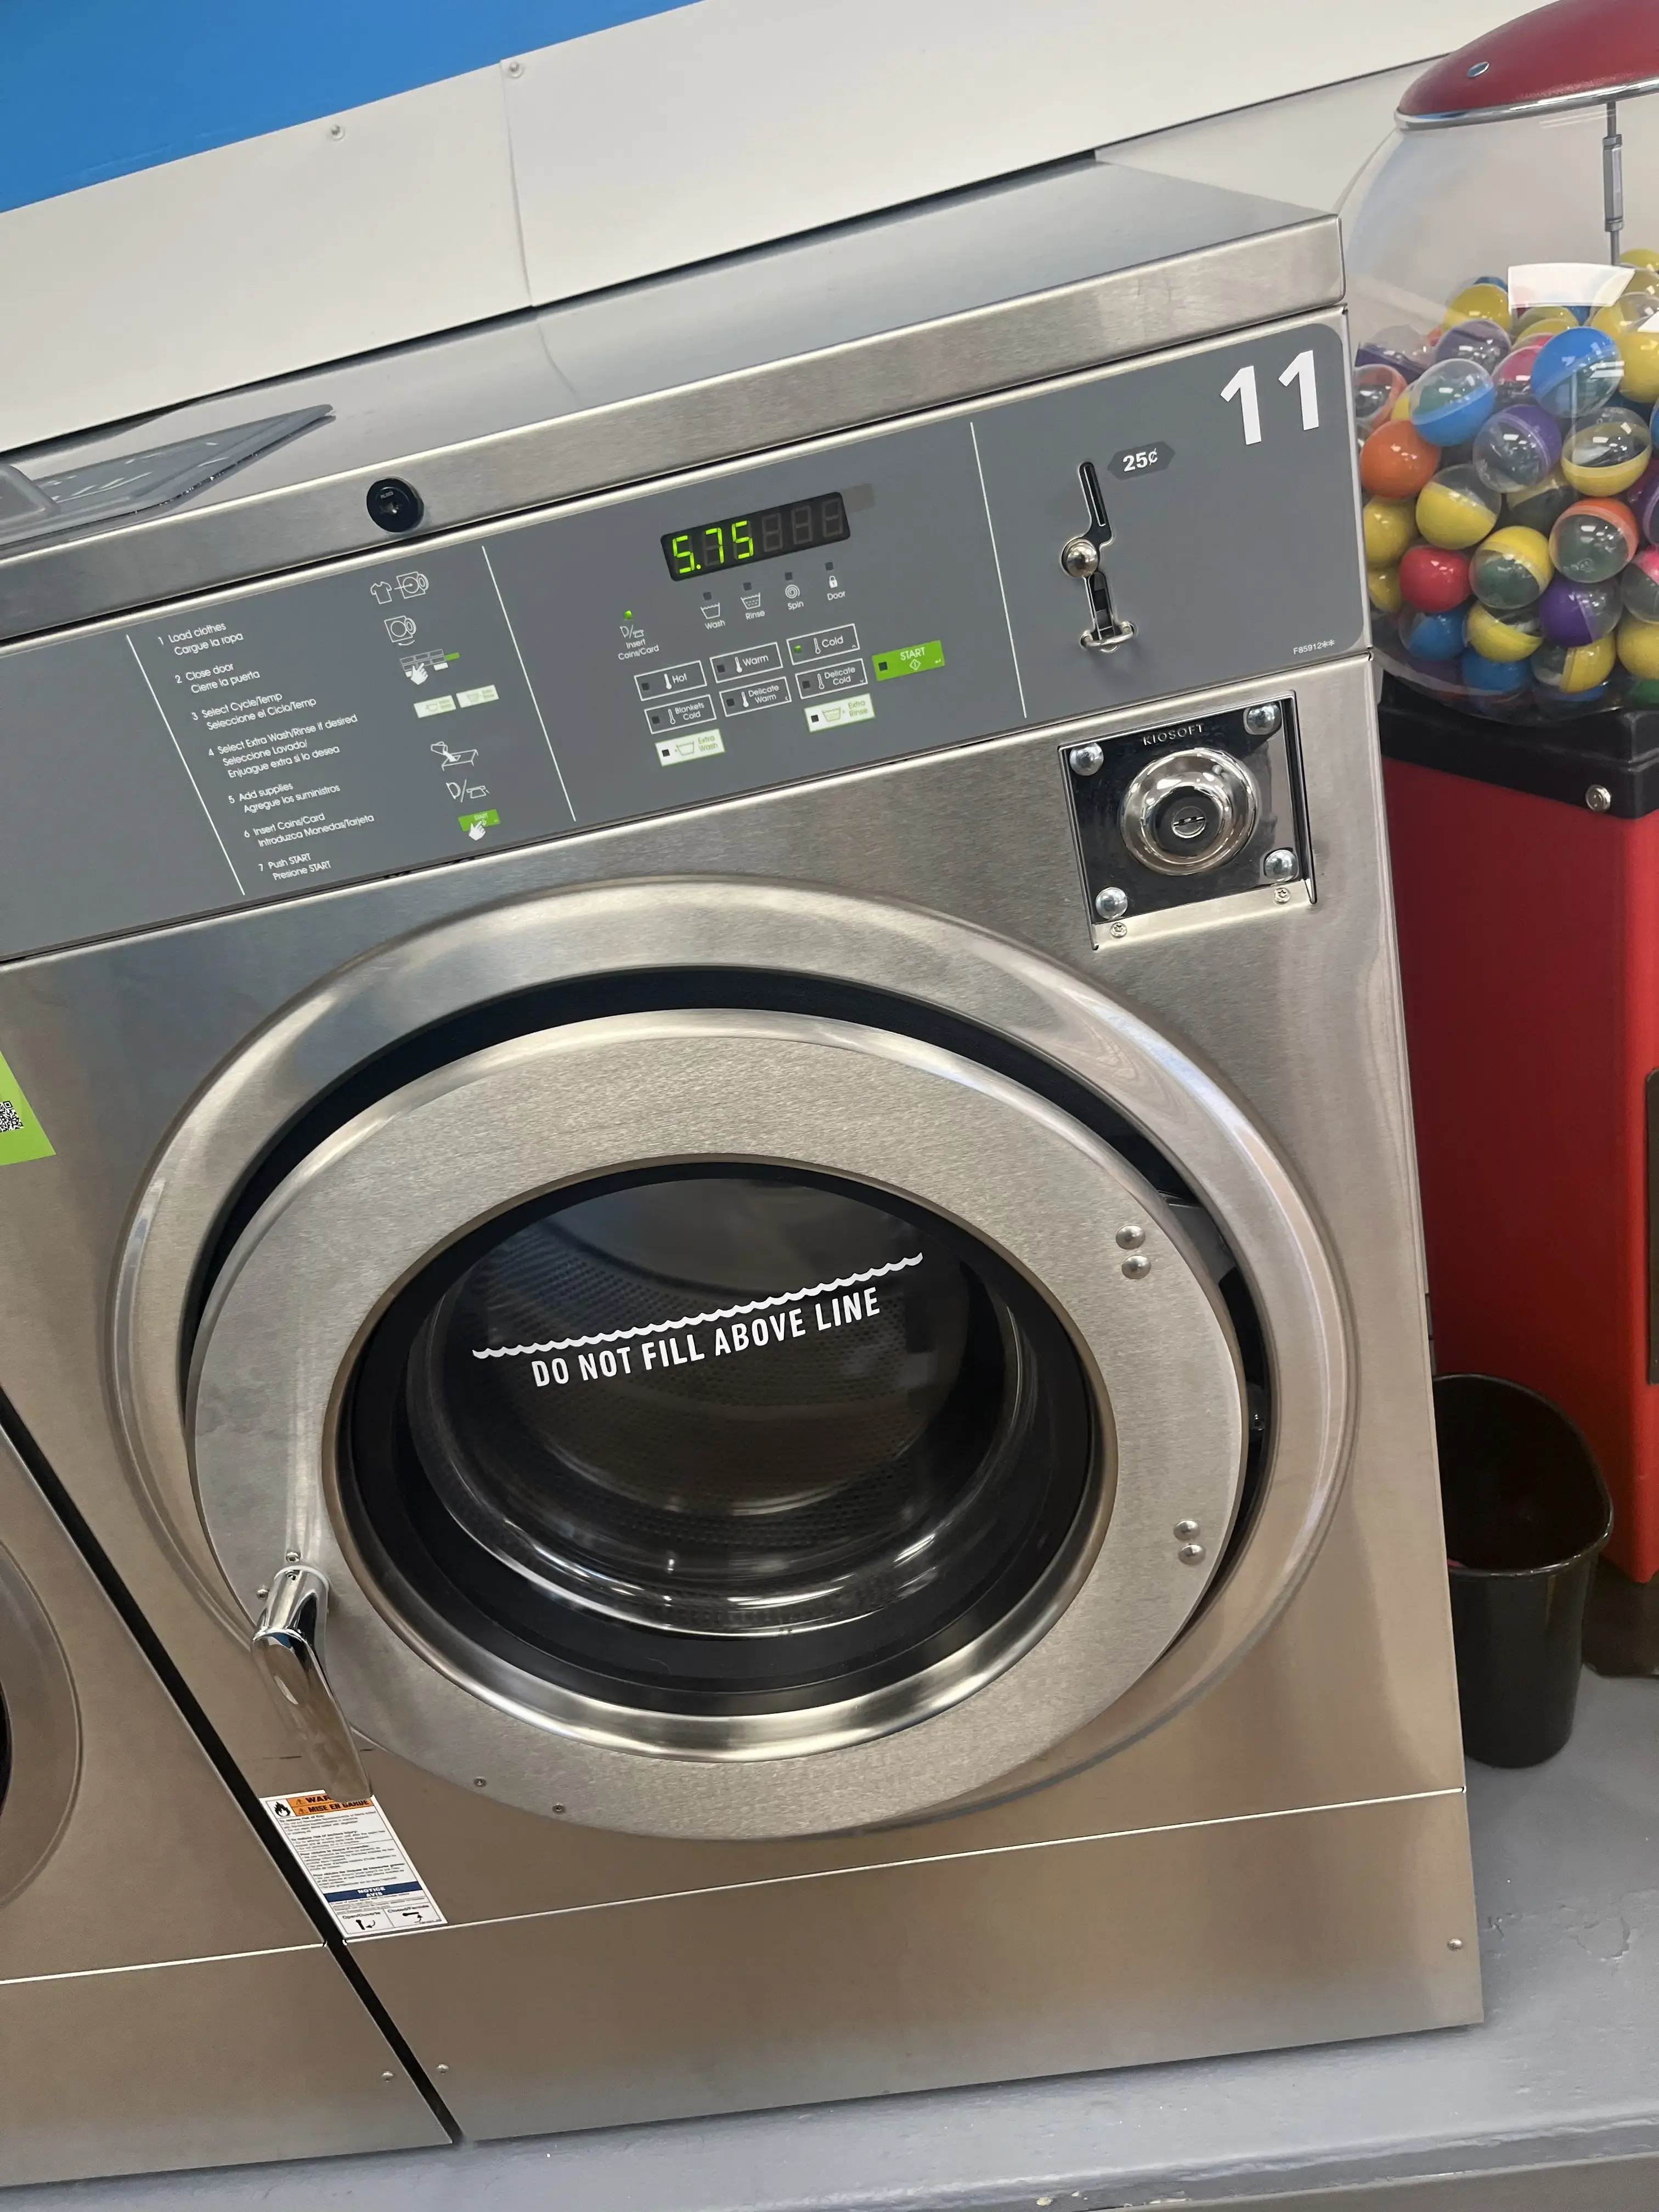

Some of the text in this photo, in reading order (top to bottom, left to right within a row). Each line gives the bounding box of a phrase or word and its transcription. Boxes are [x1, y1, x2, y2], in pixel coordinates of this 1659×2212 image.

[1220, 350, 1319, 445] 11
[1122, 448, 1158, 472] 25¢
[672, 520, 754, 574] 5.75
[827, 591, 845, 601] Door
[787, 601, 804, 611] Spin
[745, 610, 765, 620] Rinse
[704, 619, 726, 630] Wash
[158, 623, 227, 645] 1 Load clothes
[821, 635, 844, 648] Cold
[174, 633, 244, 656] Cargue la ropa
[618, 645, 659, 660] Coins/Card
[625, 639, 646, 649] Insert
[742, 654, 769, 667] Warm
[900, 647, 926, 661] START
[174, 663, 234, 684] 2 Close door
[191, 670, 261, 693] Cierre la puerta
[672, 673, 687, 684] Hot
[824, 667, 856, 680] Delicate
[832, 675, 851, 686] Cold
[748, 685, 780, 698] Delicate
[754, 694, 777, 704] Warm
[191, 693, 283, 721] 3 Select Cycle/Temp
[674, 702, 705, 715] Blankets
[848, 700, 866, 710] Extra
[849, 708, 868, 717] Rinse
[206, 697, 317, 731] Seleccione el Ciclo/Temp
[682, 711, 701, 721] Cold
[208, 714, 358, 757] 4 Select Extra Wash/Rinse if desired
[697, 735, 715, 744] Extra
[1143, 724, 1204, 746] KIOSOFT
[222, 739, 308, 766] Seleccione Lavado/
[698, 742, 719, 752] Wash
[227, 746, 340, 778] Enjuague extra si lo desea
[228, 783, 294, 804] 5 Add supplies
[244, 785, 341, 814] Agregue los suministros
[253, 823, 276, 836] Insert
[277, 812, 325, 831] Coins/Card
[258, 814, 375, 847] Introduzca Monedas/Tarjeta
[258, 853, 312, 872] 7 Push START
[272, 860, 331, 881] Presione START
[531, 1286, 881, 1387] DO NOT FILL ABOVE LINE
